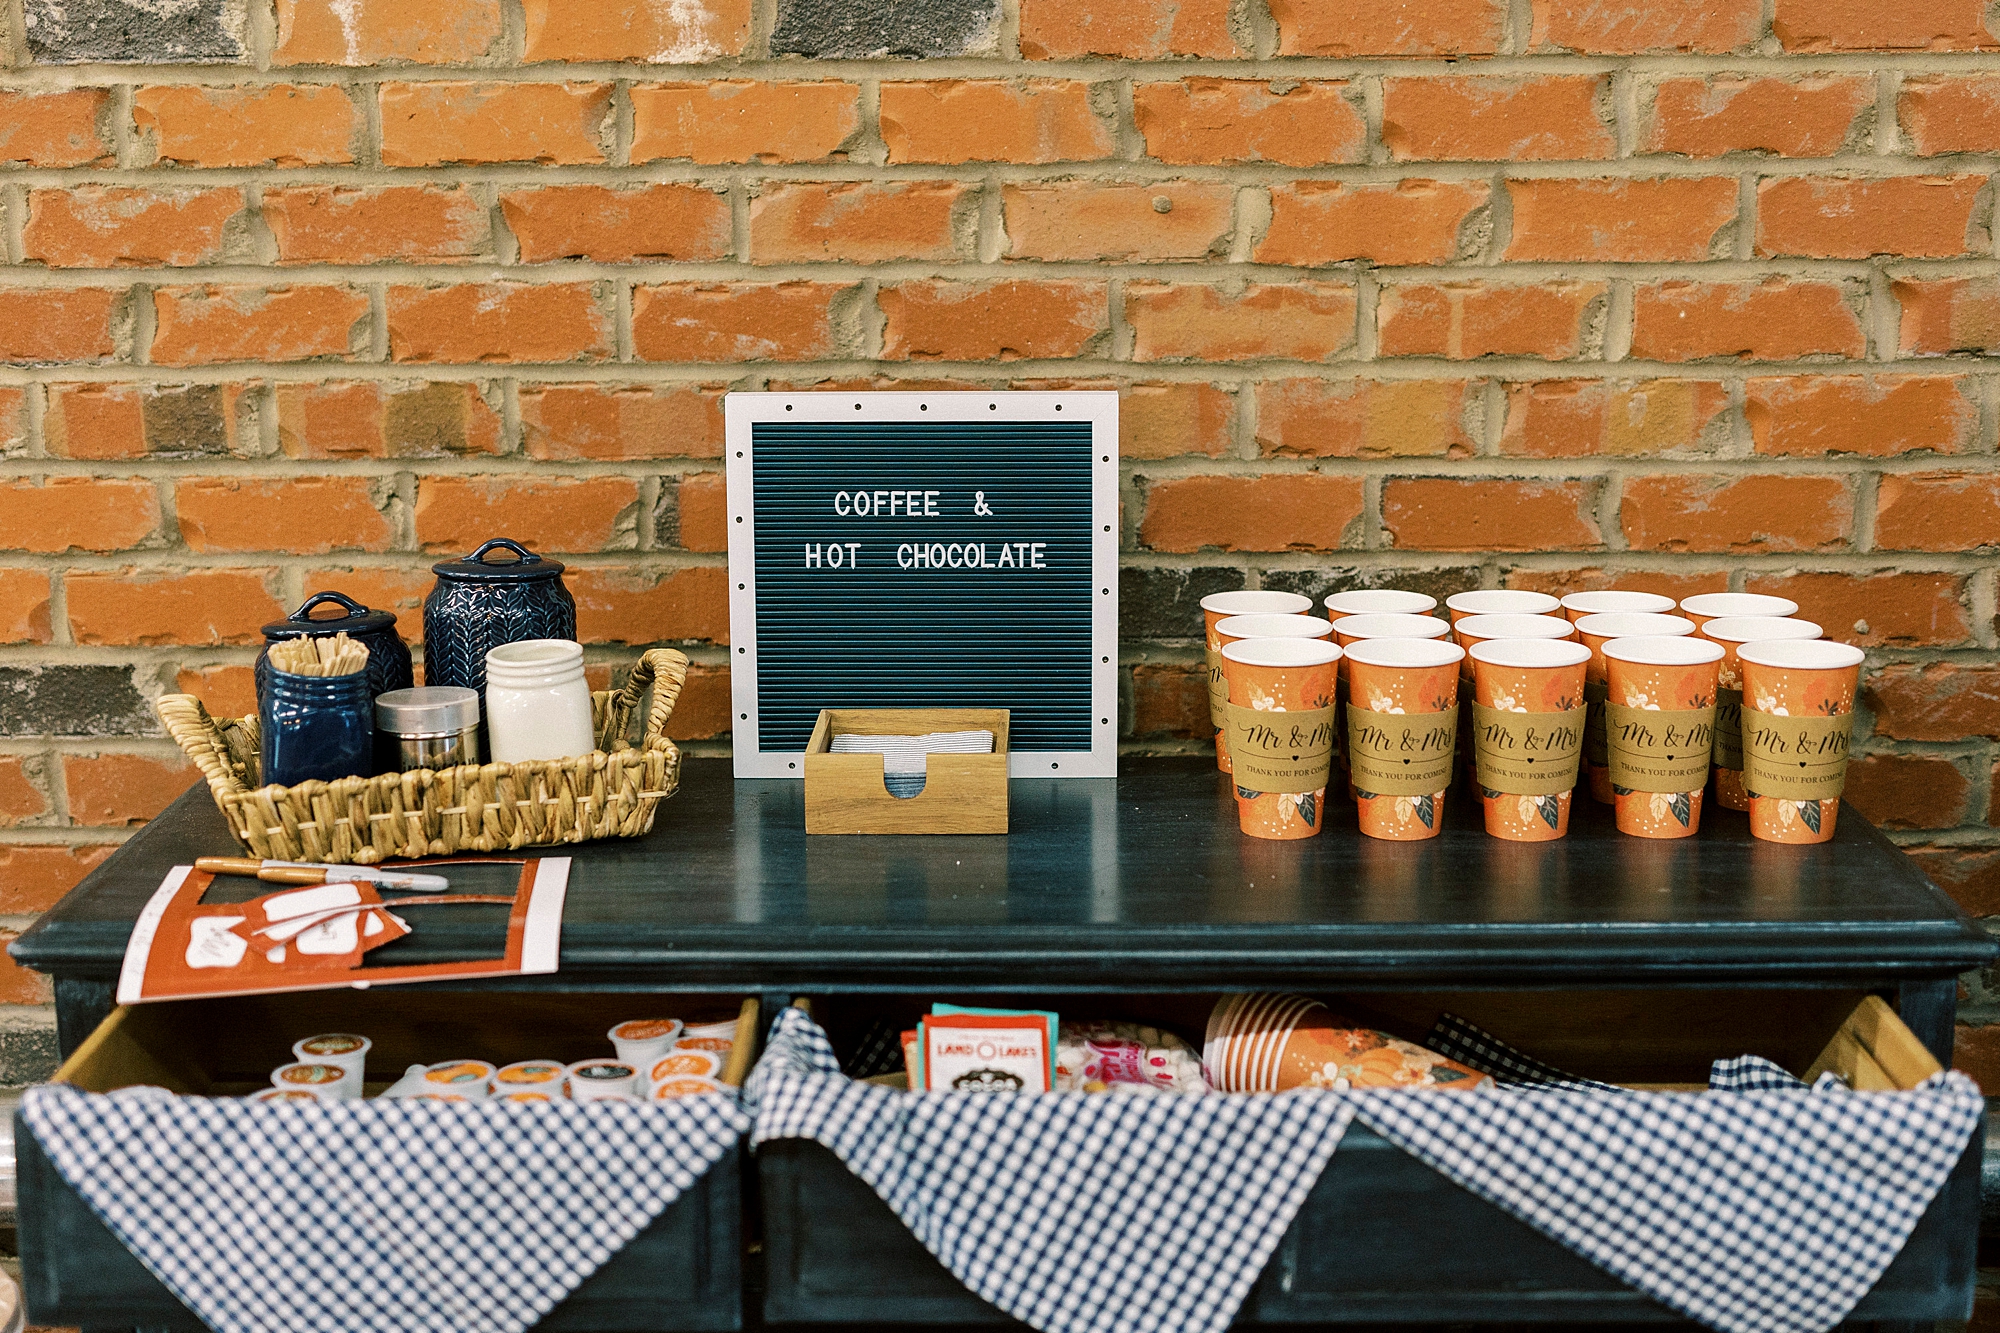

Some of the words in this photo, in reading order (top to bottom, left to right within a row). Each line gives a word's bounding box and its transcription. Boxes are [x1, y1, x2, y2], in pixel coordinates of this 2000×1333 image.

[833, 490, 941, 518] COFFEE
[973, 490, 994, 517] &
[804, 542, 862, 570] HOT
[896, 542, 1047, 570] CHOCOLATE
[1288, 724, 1309, 749] &
[1400, 728, 1420, 752] &
[1523, 726, 1545, 751] &
[1663, 723, 1684, 748] &
[1796, 730, 1818, 755] &
[1246, 764, 1273, 777] THANK
[1274, 769, 1292, 778] YOU
[1294, 767, 1310, 777] FOR
[1360, 765, 1384, 779] THANK
[1385, 772, 1403, 781] YOU
[1405, 773, 1422, 781] FOR
[1485, 762, 1508, 777] THANK
[1509, 770, 1527, 780] YOU
[1529, 771, 1546, 780] FOR
[1620, 761, 1647, 776] THANK
[1648, 768, 1666, 777] YOU
[1668, 769, 1685, 777] FOR
[1753, 767, 1779, 782] THANK
[1779, 775, 1798, 784] YOU
[1800, 776, 1818, 784] FOR
[937, 1043, 974, 1057] LAND
[999, 1045, 1038, 1059] LAKES
